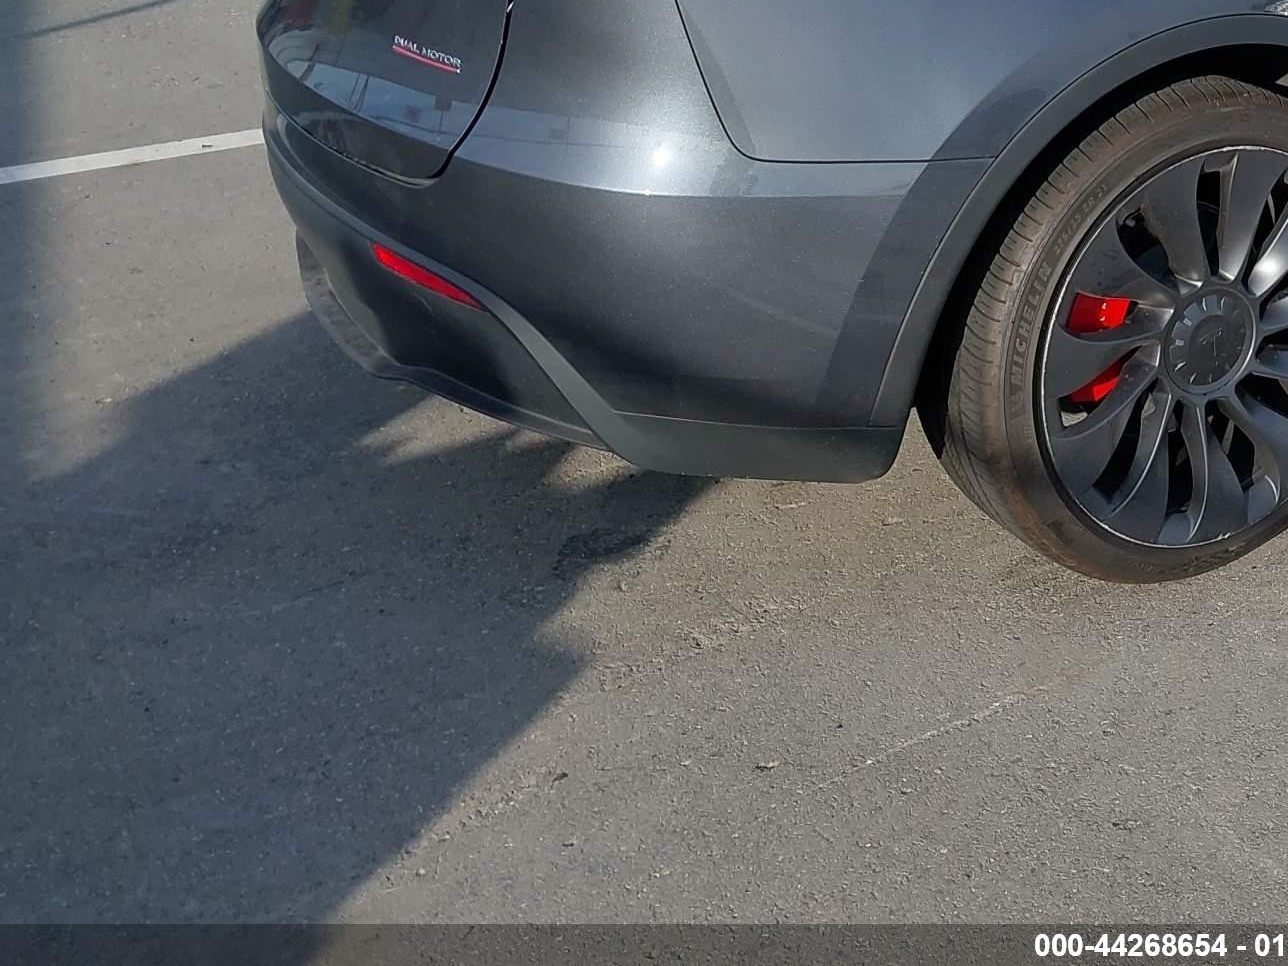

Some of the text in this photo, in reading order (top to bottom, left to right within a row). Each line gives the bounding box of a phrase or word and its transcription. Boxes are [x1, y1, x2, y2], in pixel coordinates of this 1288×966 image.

[394, 35, 461, 68] DUAL MOTOR
[1009, 260, 1052, 390] MICHELIN
